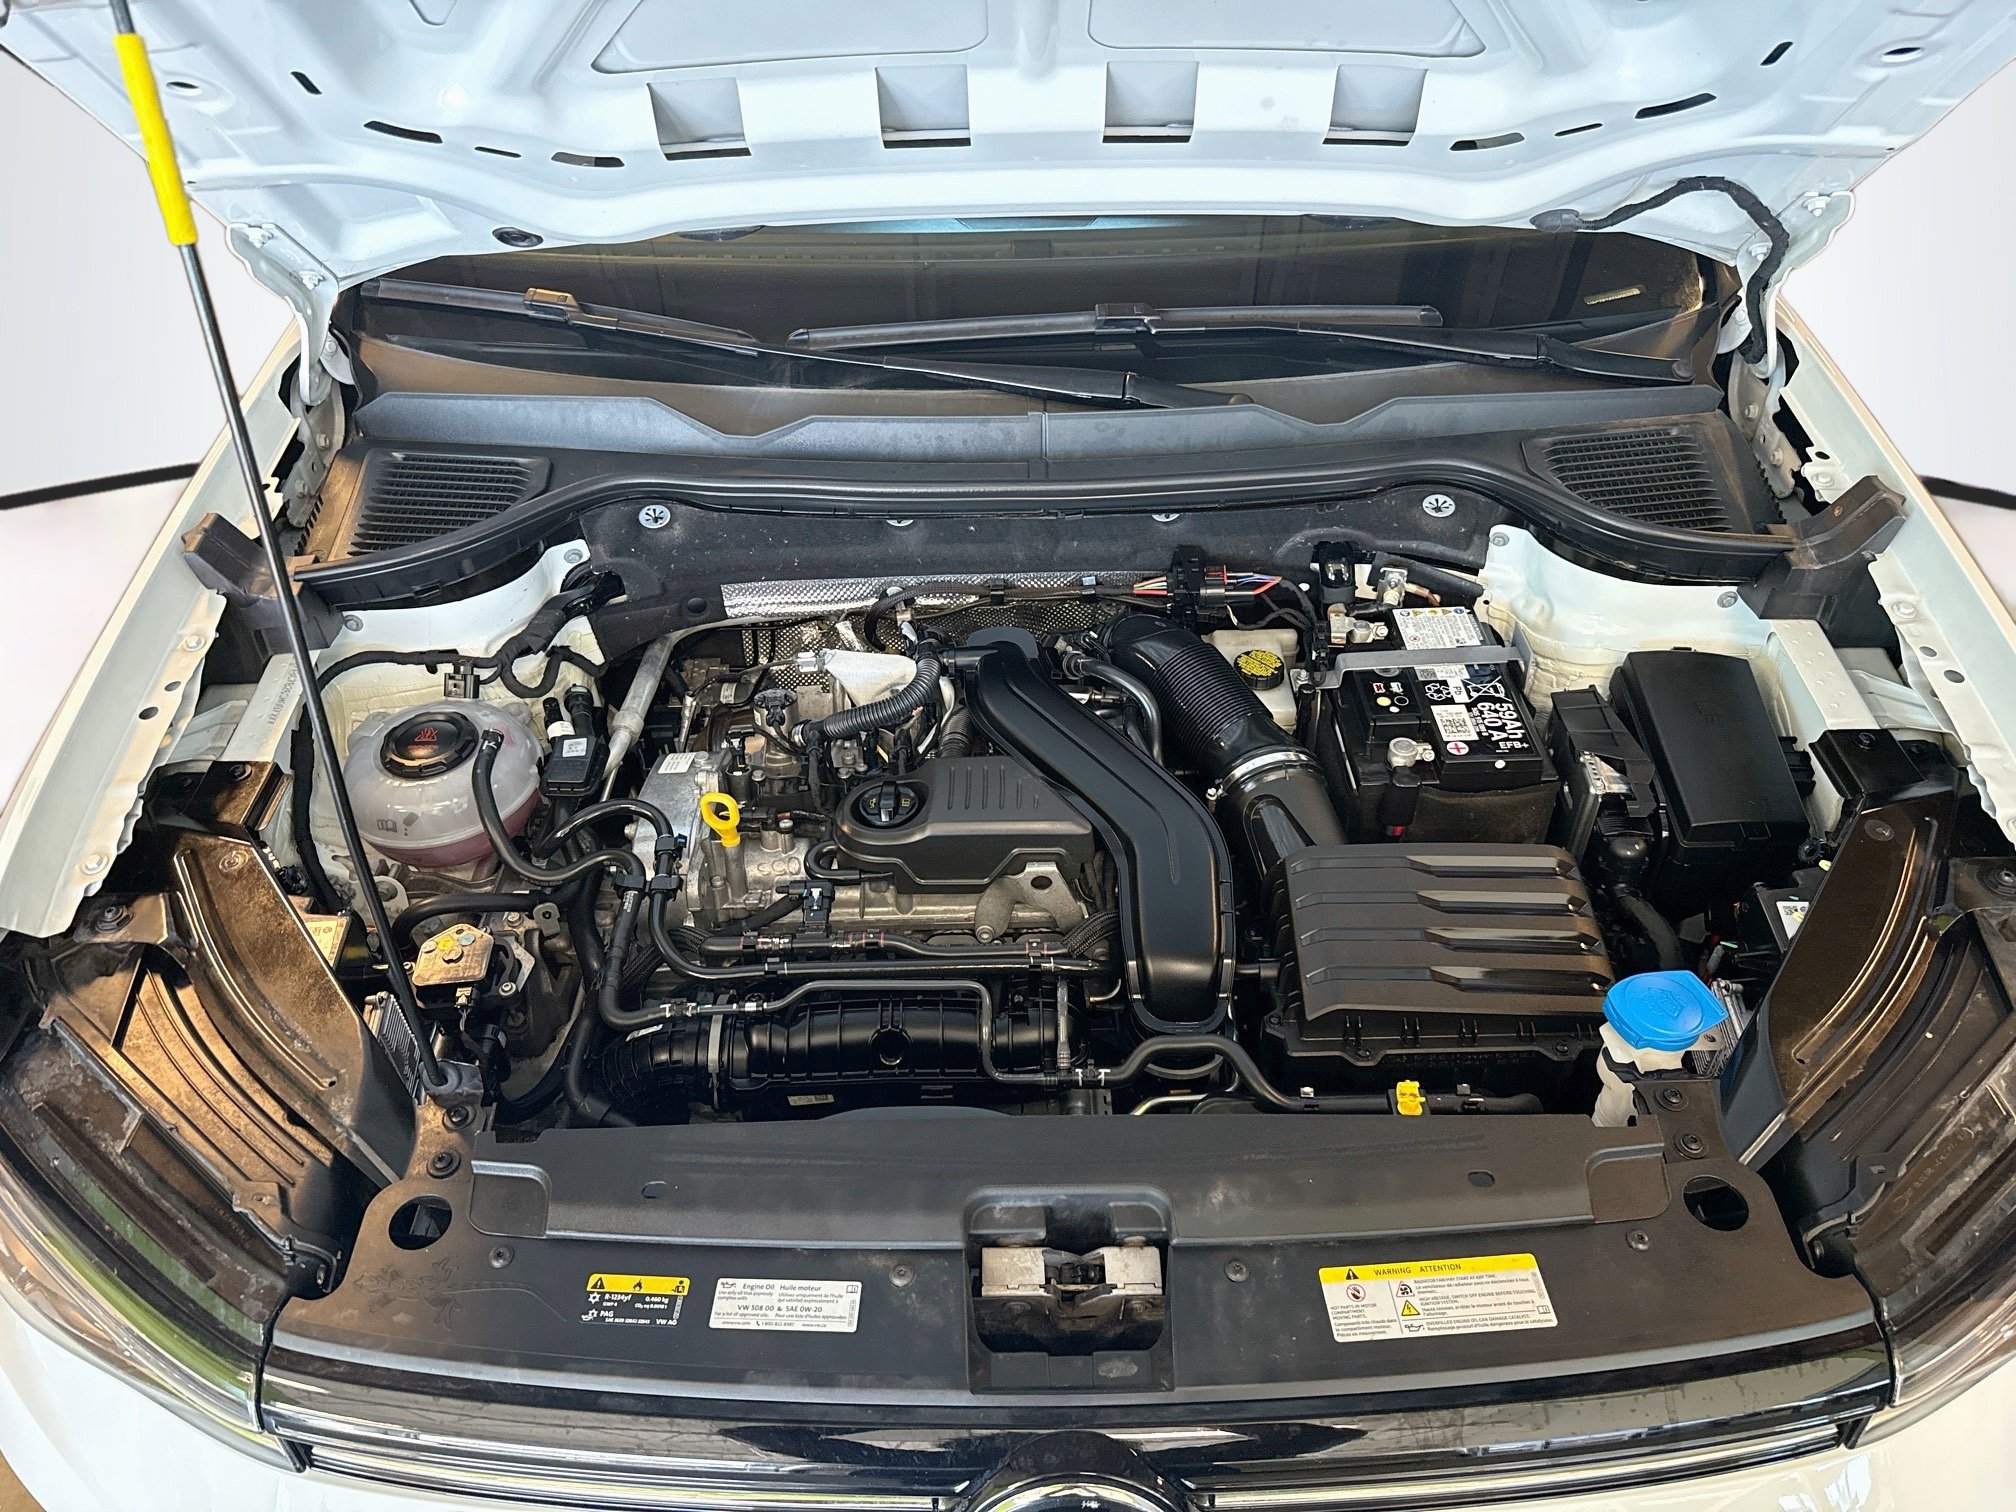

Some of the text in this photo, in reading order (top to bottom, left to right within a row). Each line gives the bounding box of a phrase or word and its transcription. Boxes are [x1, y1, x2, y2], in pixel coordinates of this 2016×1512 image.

[1453, 687, 1462, 695] Pb
[1477, 703, 1502, 726] 640
[1495, 703, 1526, 738] 59Ah
[1488, 730, 1508, 741] A
[1374, 1267, 1411, 1276] WARNING
[604, 1294, 632, 1302] R-1234yf
